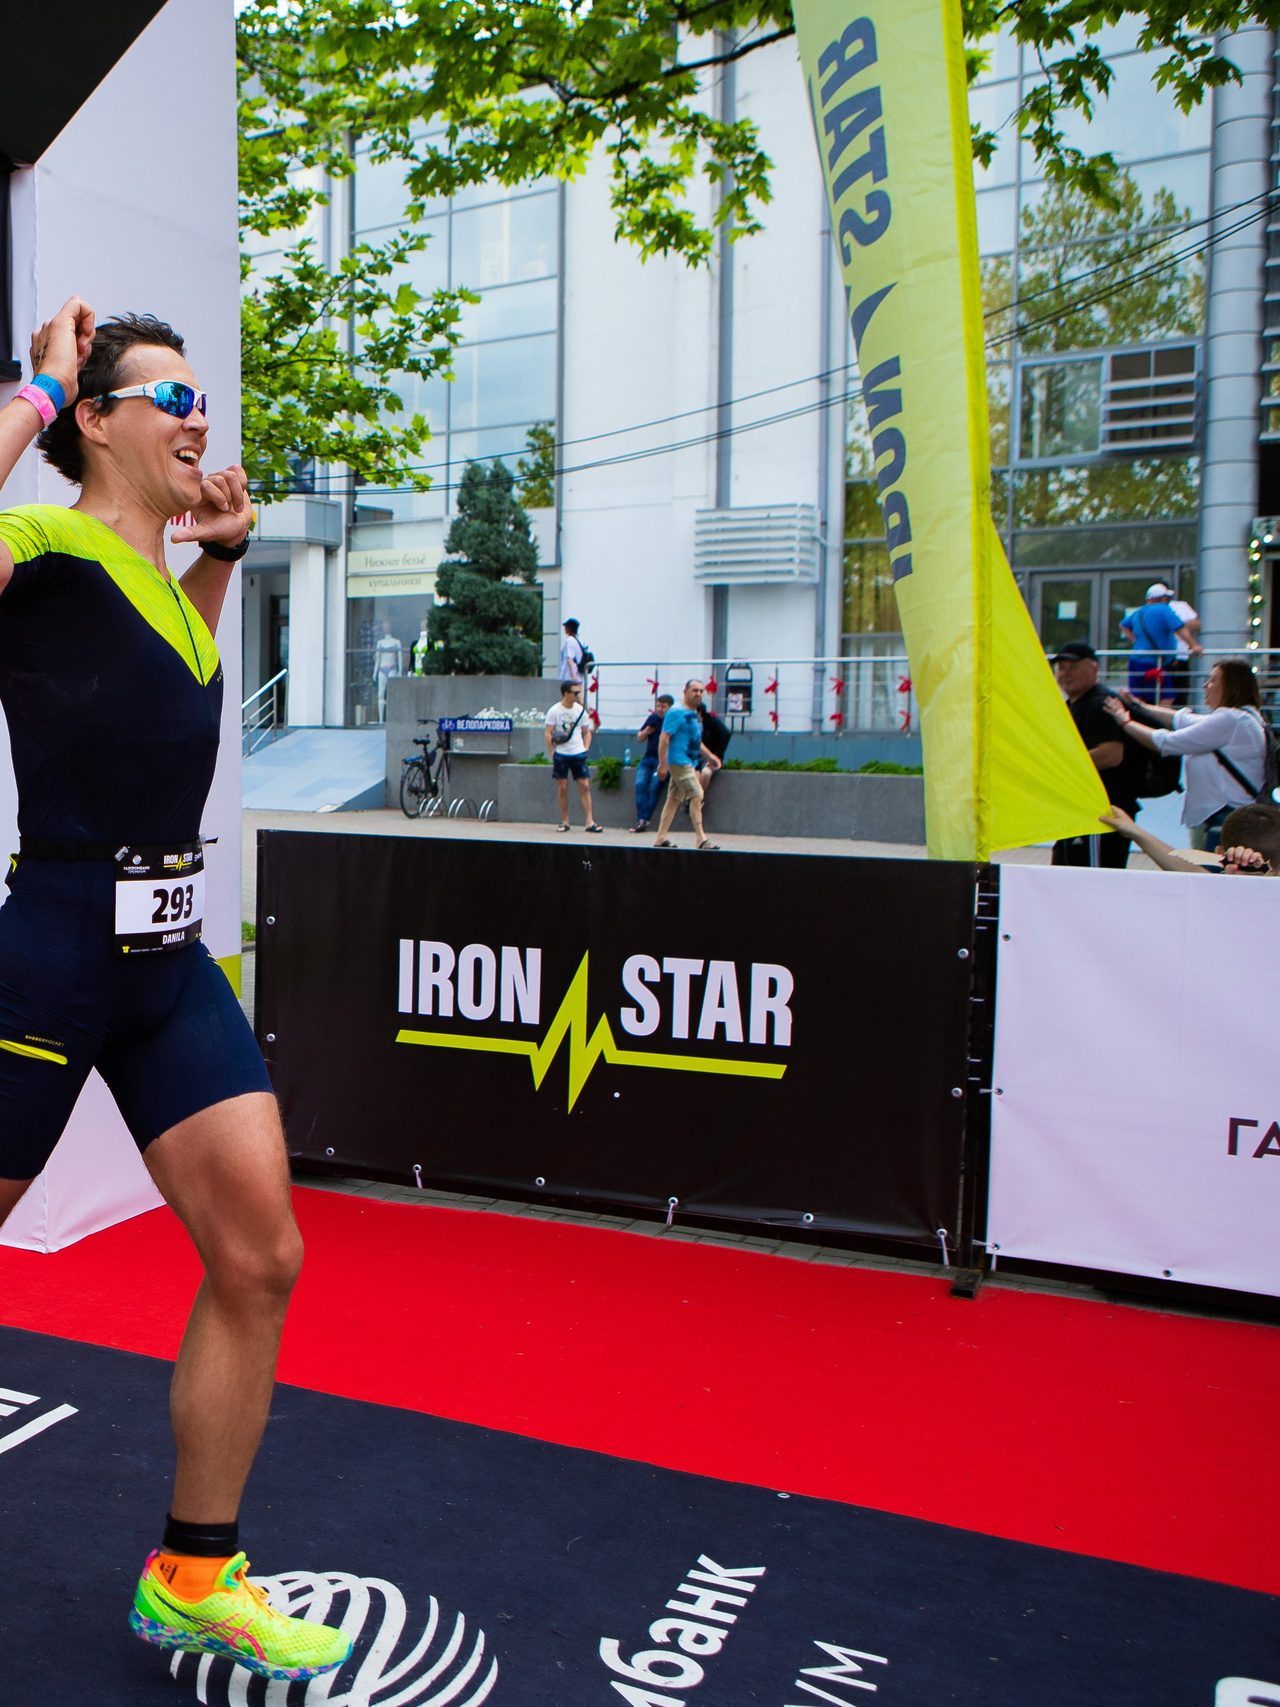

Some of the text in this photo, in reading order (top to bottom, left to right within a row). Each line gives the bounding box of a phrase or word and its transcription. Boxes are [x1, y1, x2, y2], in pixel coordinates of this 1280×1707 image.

[456, 719, 511, 731] ВЕЛОПАРКОВКА
[151, 883, 194, 924] 293
[162, 931, 185, 945] DANILA
[397, 938, 795, 1047] IRON STAR
